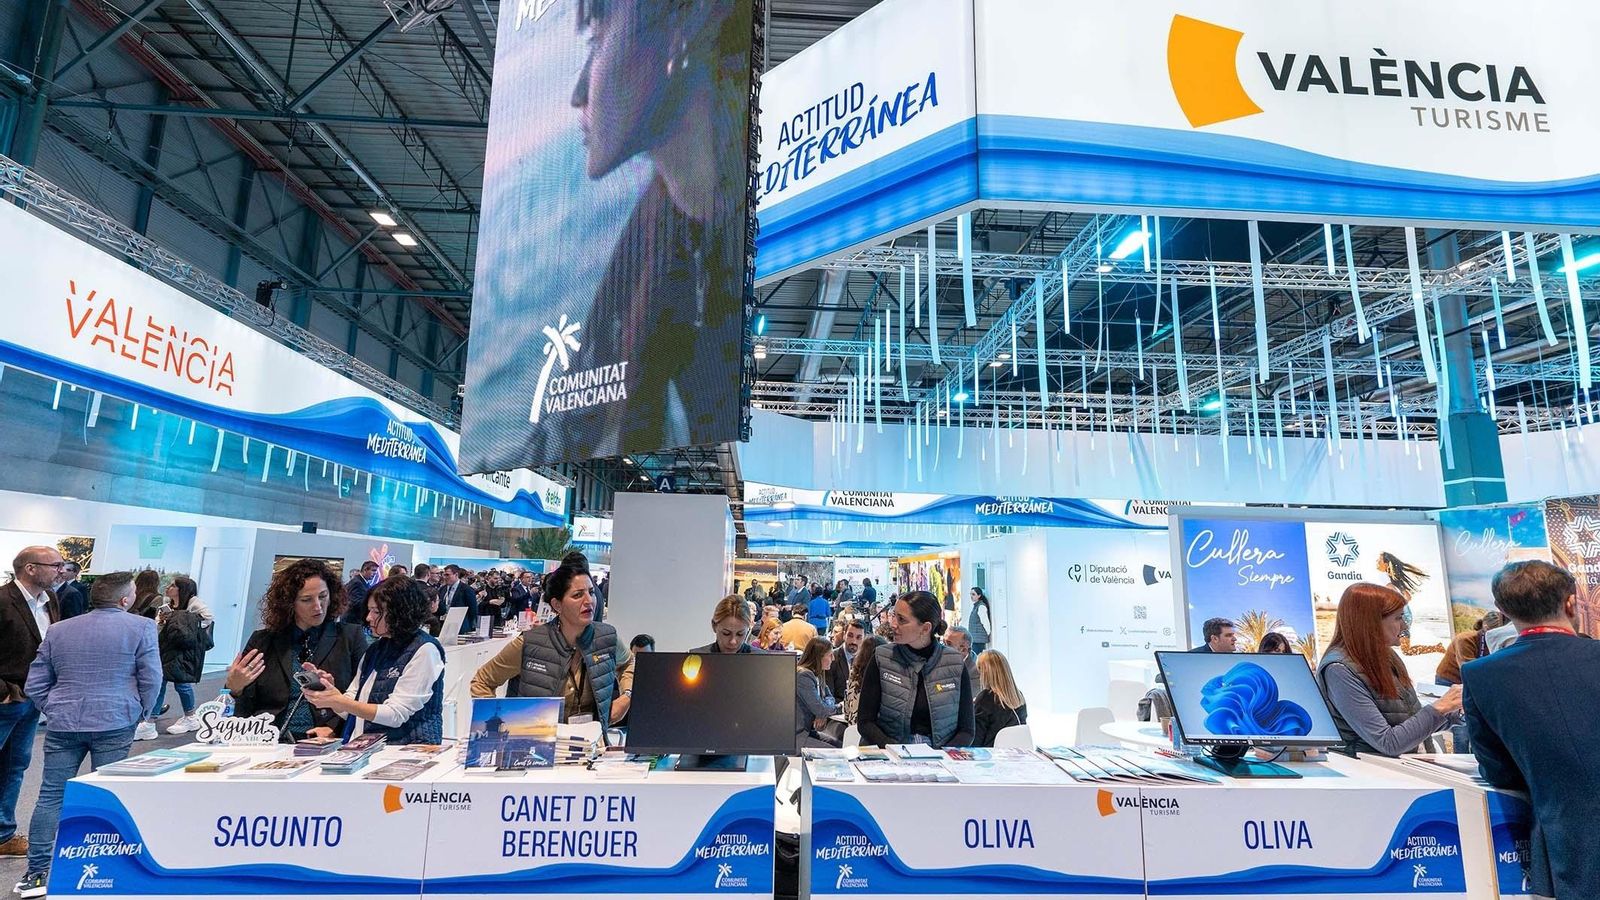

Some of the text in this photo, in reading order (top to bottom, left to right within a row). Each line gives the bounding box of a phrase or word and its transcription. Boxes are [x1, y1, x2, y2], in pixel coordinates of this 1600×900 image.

[1257, 48, 1546, 104] VALÈNCIA
[778, 82, 864, 150] ACTITUD
[1411, 107, 1551, 133] TURISME
[757, 72, 938, 202] DITERRÁNEA
[549, 361, 629, 395] COMUNITAT
[546, 382, 628, 414] VALENCIANA
[387, 419, 413, 443] ACTITUD
[367, 433, 427, 463] MEDITERRÁNEA
[660, 478, 671, 490] A
[831, 496, 895, 508] VALENCIANA
[975, 499, 1054, 516] MEDITERRÁNEA
[1132, 505, 1168, 515] VALENC
[1186, 529, 1285, 568] Cullera
[1455, 527, 1522, 557] Cullera
[1089, 564, 1128, 575] Diputació
[1327, 571, 1363, 581] Gandia
[1567, 560, 1600, 574] Gand
[1089, 575, 1135, 585] de València
[1237, 564, 1295, 590] Siempre
[405, 789, 472, 804] VALÈNCIA
[1116, 796, 1179, 809] VALÈNCIA
[501, 795, 636, 823] CANET D'EN
[83, 833, 120, 844] ACTITUD
[214, 815, 343, 848] SAGUNTO
[715, 834, 748, 844] ACTITUD
[835, 835, 867, 846] ACTITUD
[963, 818, 1036, 850] OLIVA
[1243, 820, 1313, 850] OLIVA
[59, 840, 142, 859] MEDITERRÁNEA
[502, 830, 638, 858] BERENGUER
[695, 841, 769, 859] MEDITERRÁNEA
[1407, 836, 1437, 846] ACTITUD
[815, 842, 889, 860] MEDITERRÁNEA
[1390, 843, 1458, 861] MEDITERRÁNEA
